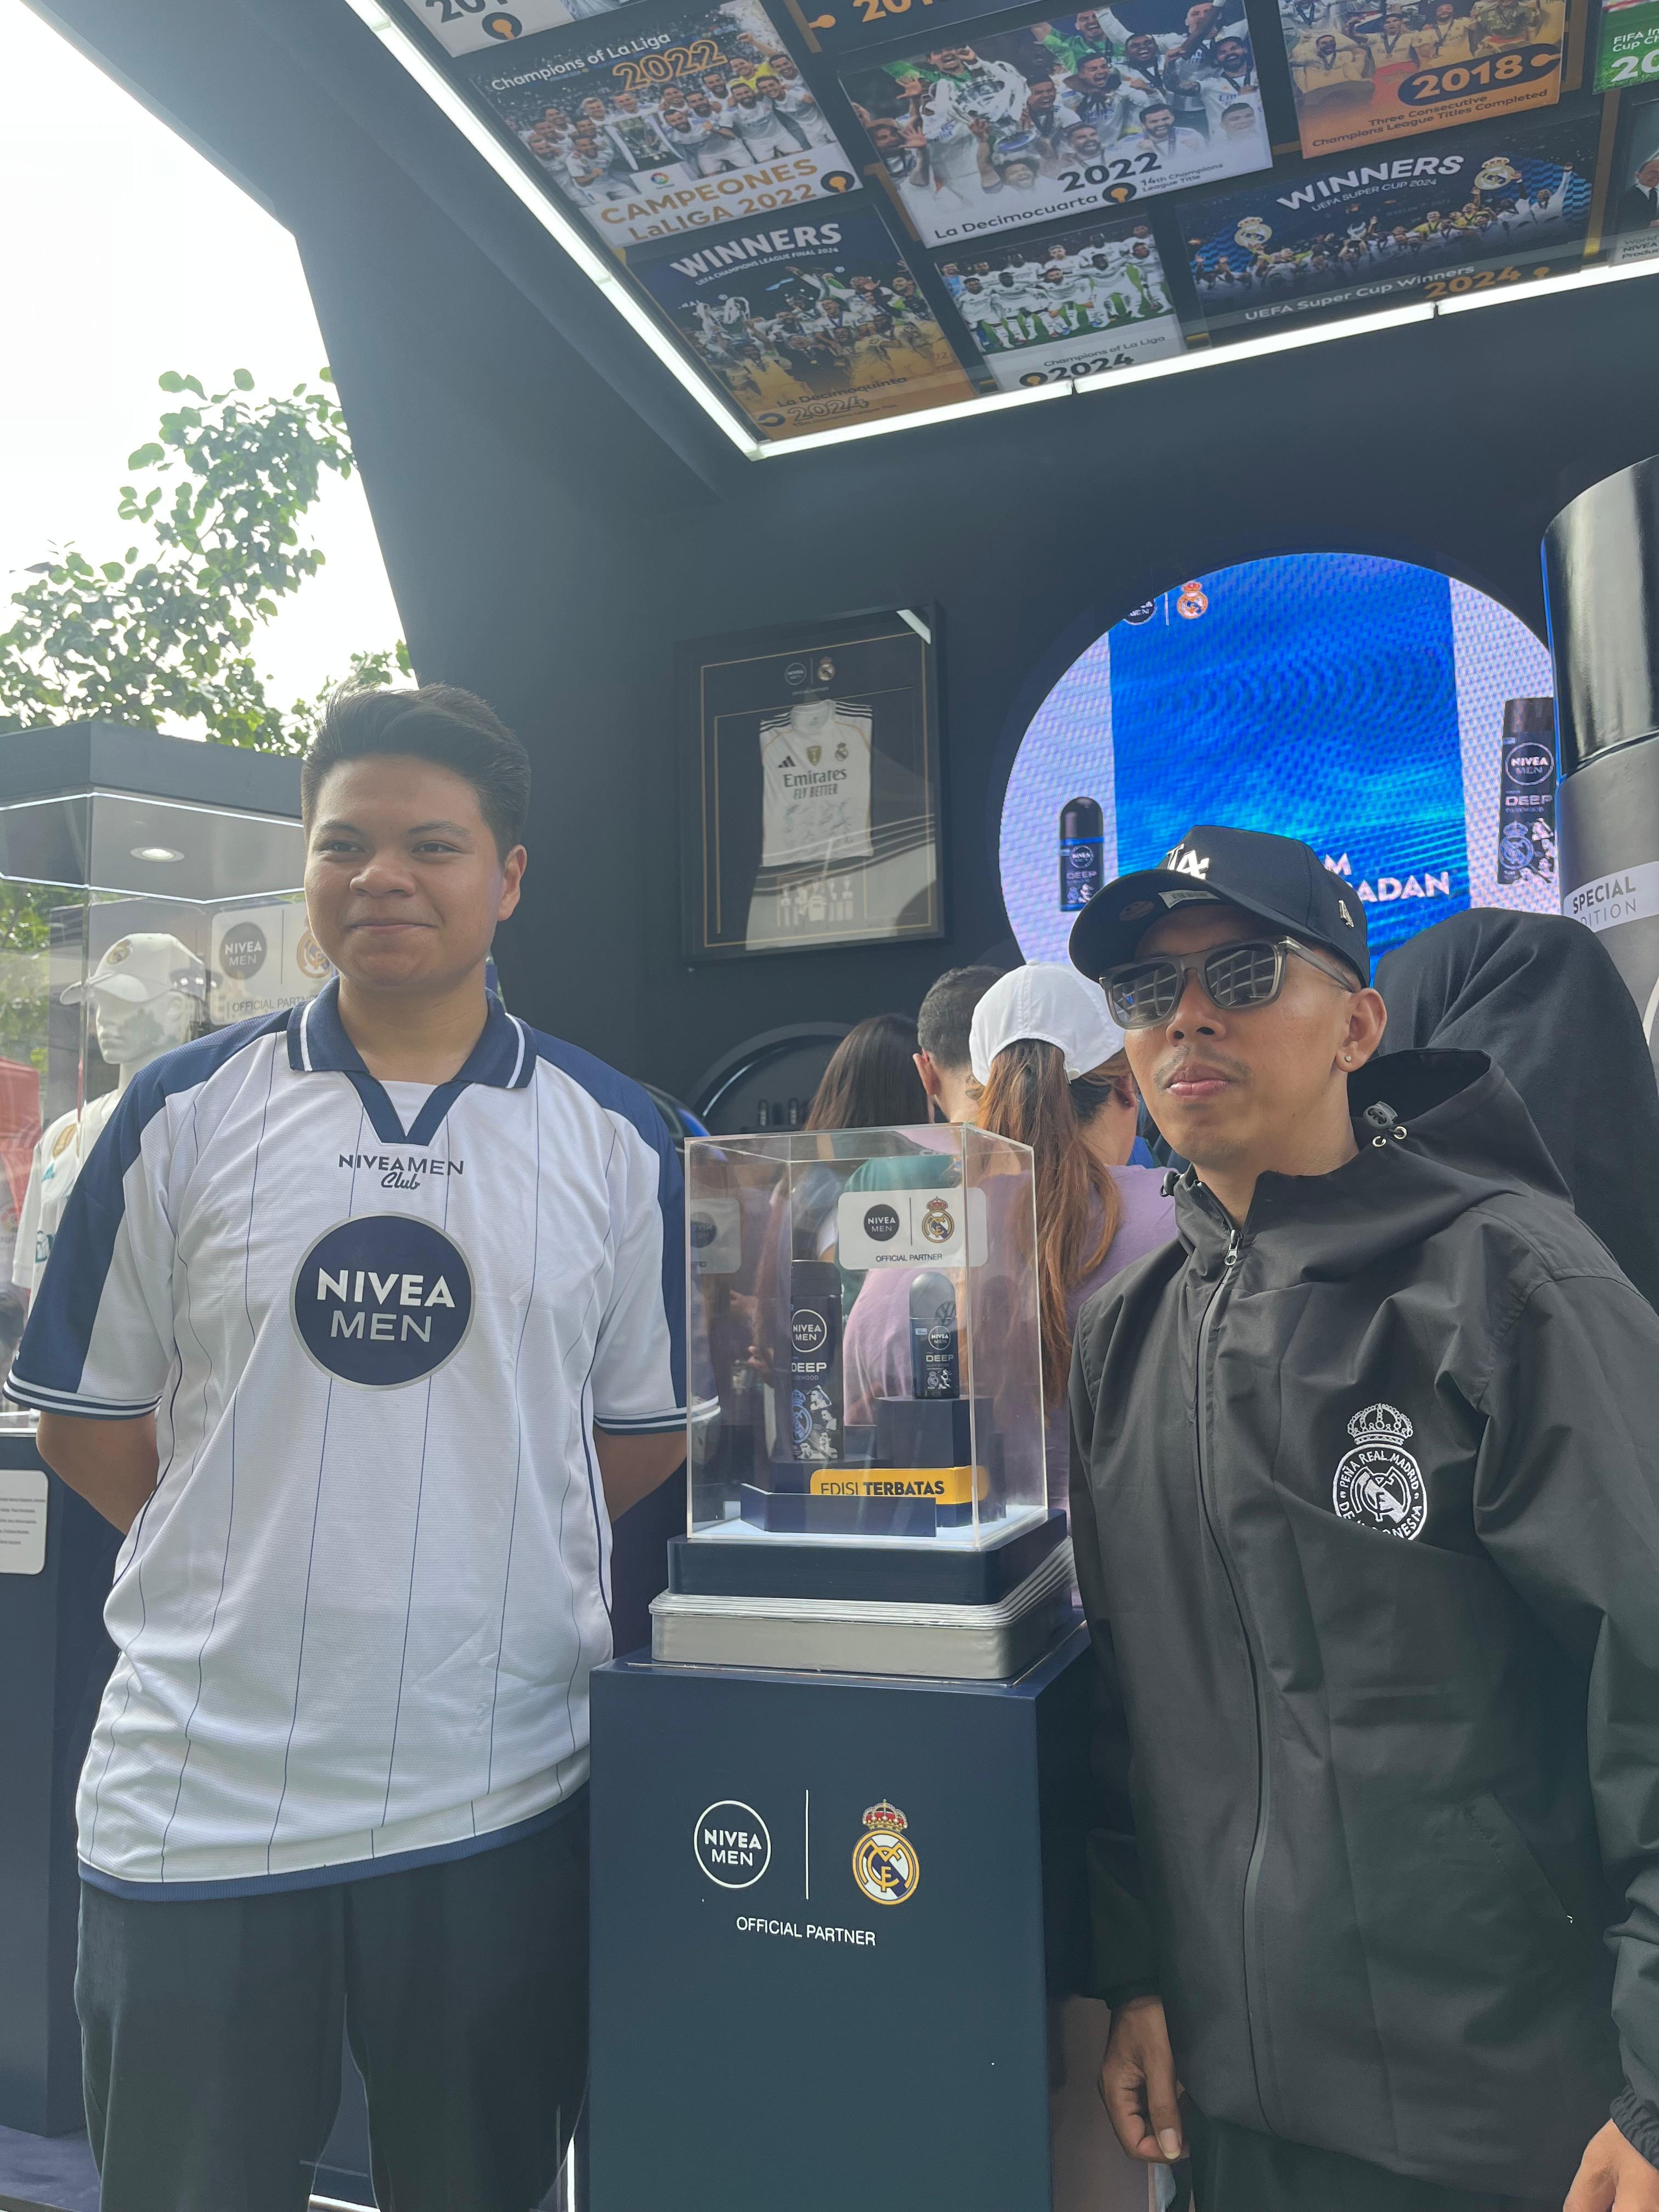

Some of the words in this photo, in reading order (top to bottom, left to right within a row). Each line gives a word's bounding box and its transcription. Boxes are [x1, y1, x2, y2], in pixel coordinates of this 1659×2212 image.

[426, 0, 507, 23] 20
[853, 0, 933, 22] 20
[1612, 41, 1640, 52] Cup
[1613, 31, 1644, 44] FIFA
[492, 57, 585, 91] Champions
[589, 48, 607, 64] of
[607, 42, 630, 58] La
[631, 32, 671, 53] Liga
[612, 39, 728, 92] 2022
[1412, 55, 1523, 100] 2018
[1312, 126, 1384, 148] Champions
[1386, 115, 1434, 132] League
[1437, 108, 1472, 120] Titles
[1475, 89, 1548, 111] Completed
[1368, 112, 1406, 127] Three
[1408, 95, 1488, 117] Consecutive
[1057, 152, 1163, 193] 2022
[1142, 180, 1178, 192] League
[1180, 174, 1200, 184] Title
[1169, 164, 1224, 182] Champions
[1276, 156, 1464, 210] WINNERS
[600, 159, 819, 224] CAMPEONES
[1311, 198, 1341, 212] UEFA
[1342, 185, 1380, 202] SUPER
[1381, 180, 1408, 191] CUP
[1409, 178, 1437, 188] 2024
[627, 206, 736, 241] LaLIGA
[737, 183, 816, 215] 2022
[934, 225, 961, 240] La
[963, 194, 1098, 234] Decimocuarta
[669, 223, 842, 278] WINNERS
[714, 259, 759, 279] CHAMPIONS
[759, 253, 791, 265] LEAGUE
[791, 249, 816, 258] FINAL
[1244, 303, 1294, 321] UEFA
[1296, 291, 1353, 311] Super
[1356, 283, 1393, 299] Cup
[1396, 266, 1476, 290] Winners
[1423, 266, 1521, 298] 2024
[1043, 349, 1108, 367] Champions
[1109, 345, 1121, 353] of
[1123, 342, 1138, 350] La
[1139, 336, 1166, 346] Liga
[1048, 353, 1135, 381] 2024
[777, 399, 796, 408] La
[799, 377, 908, 403] Decimoquinta
[787, 395, 870, 422] 2024
[1510, 757, 1549, 766] NIVEA
[783, 769, 848, 787] Emirates
[793, 787, 807, 800] FLY
[810, 783, 839, 798] BETTER
[1505, 794, 1553, 806] DEEP
[1347, 871, 1449, 903] ADAN
[1573, 876, 1637, 914] SPECIAL
[1577, 898, 1637, 927] DITION
[224, 940, 263, 955] NIVEA
[229, 955, 257, 967] MEN
[232, 997, 275, 1012] OFFICIAL
[338, 1154, 405, 1171] NIVEA
[407, 1156, 465, 1176] MEN
[380, 1171, 421, 1190] Club
[867, 1216, 896, 1225] NIVEA
[909, 1253, 943, 1261] PARTNER
[316, 1267, 456, 1308] NIVEA
[330, 1310, 432, 1343] MEN
[793, 1323, 822, 1333] NIVEA
[795, 1333, 817, 1341] MEN
[791, 1362, 827, 1373] DEEP
[926, 1354, 954, 1362] DEEP
[1340, 1460, 1361, 1488] PEÑA
[1358, 1450, 1388, 1466] REAL
[1389, 1453, 1420, 1491] MADRID
[863, 1480, 945, 1496] TERBATAS
[1339, 1501, 1356, 1520] DE
[704, 1829, 763, 1850] NIVEA
[712, 1849, 754, 1866] MEN
[736, 1916, 803, 1938] OFFICIAL
[806, 1924, 877, 1946] PARTNER
